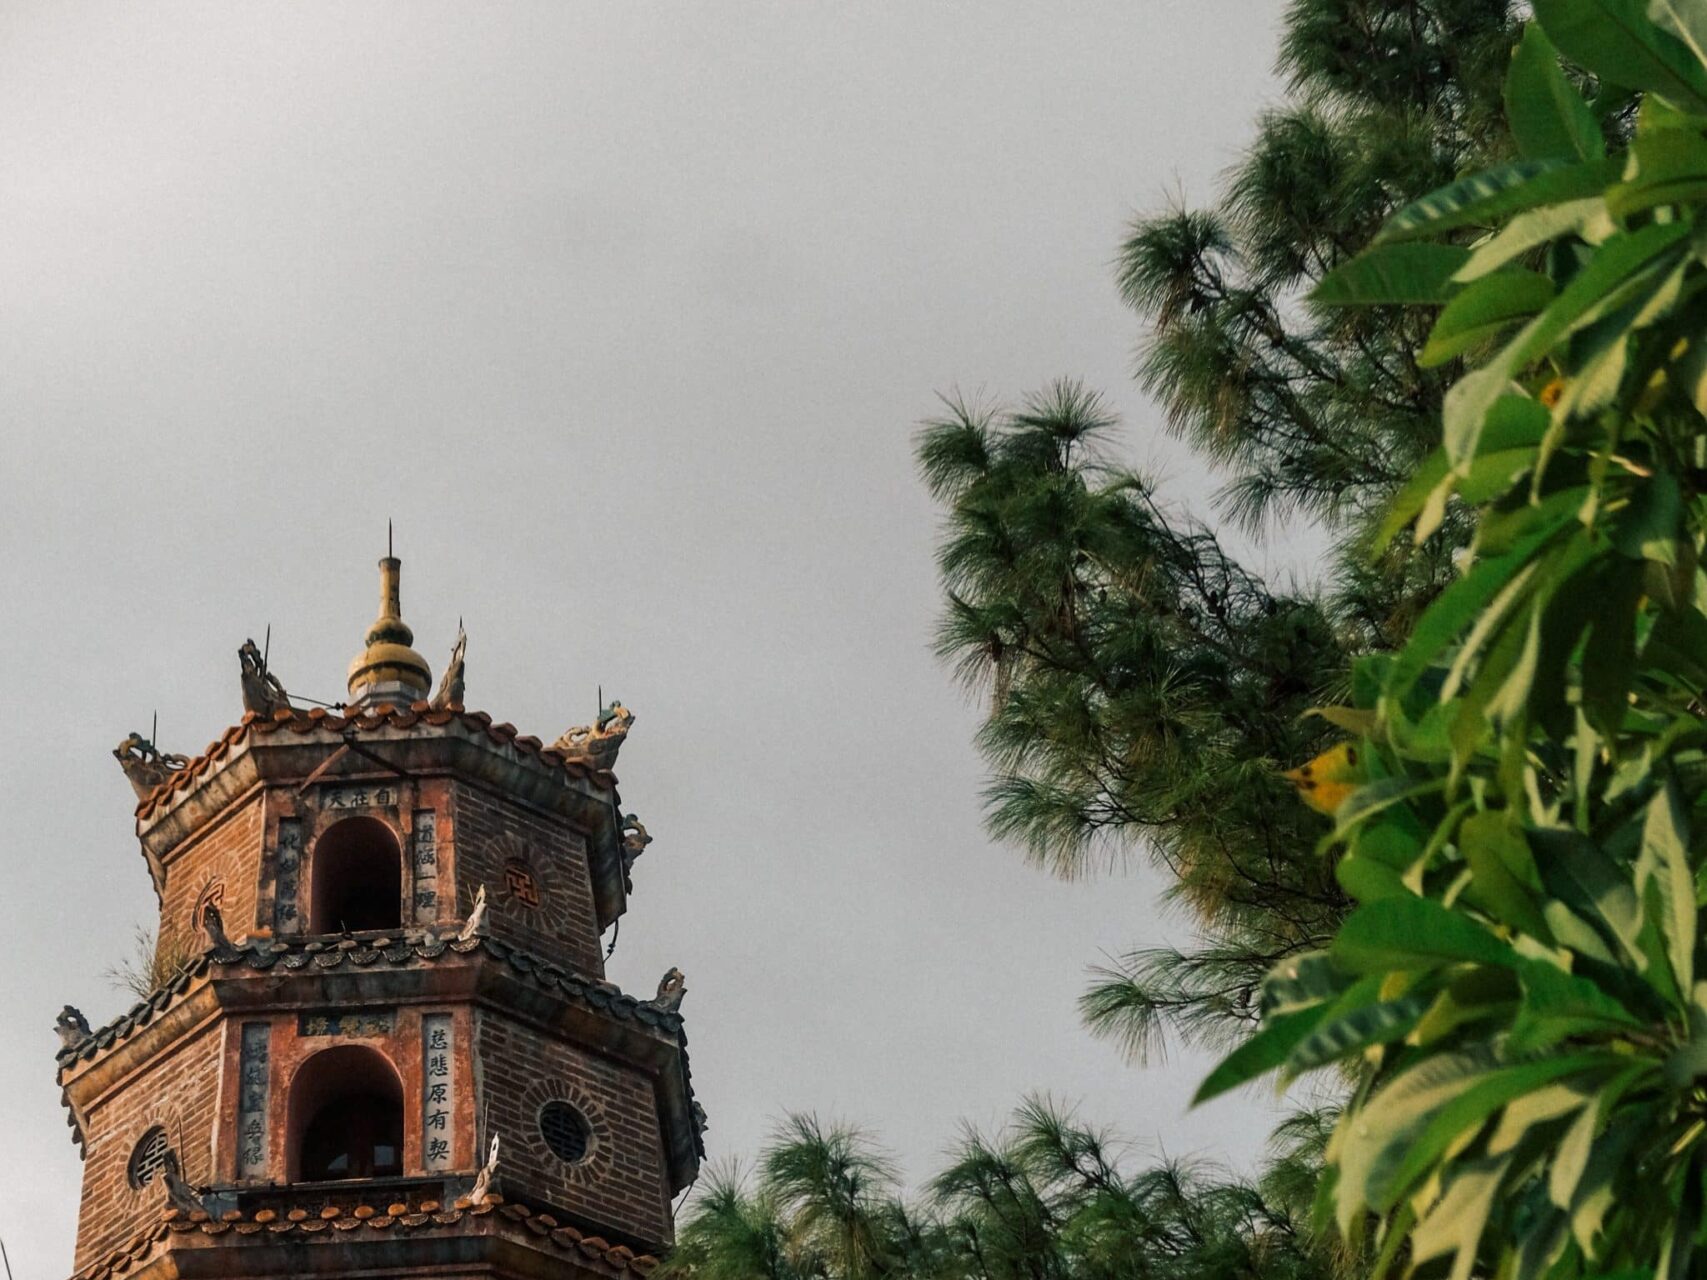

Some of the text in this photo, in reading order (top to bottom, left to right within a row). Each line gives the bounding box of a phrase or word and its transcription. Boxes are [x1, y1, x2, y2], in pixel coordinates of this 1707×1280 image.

[427, 1028, 450, 1161] 慈悲原有契
